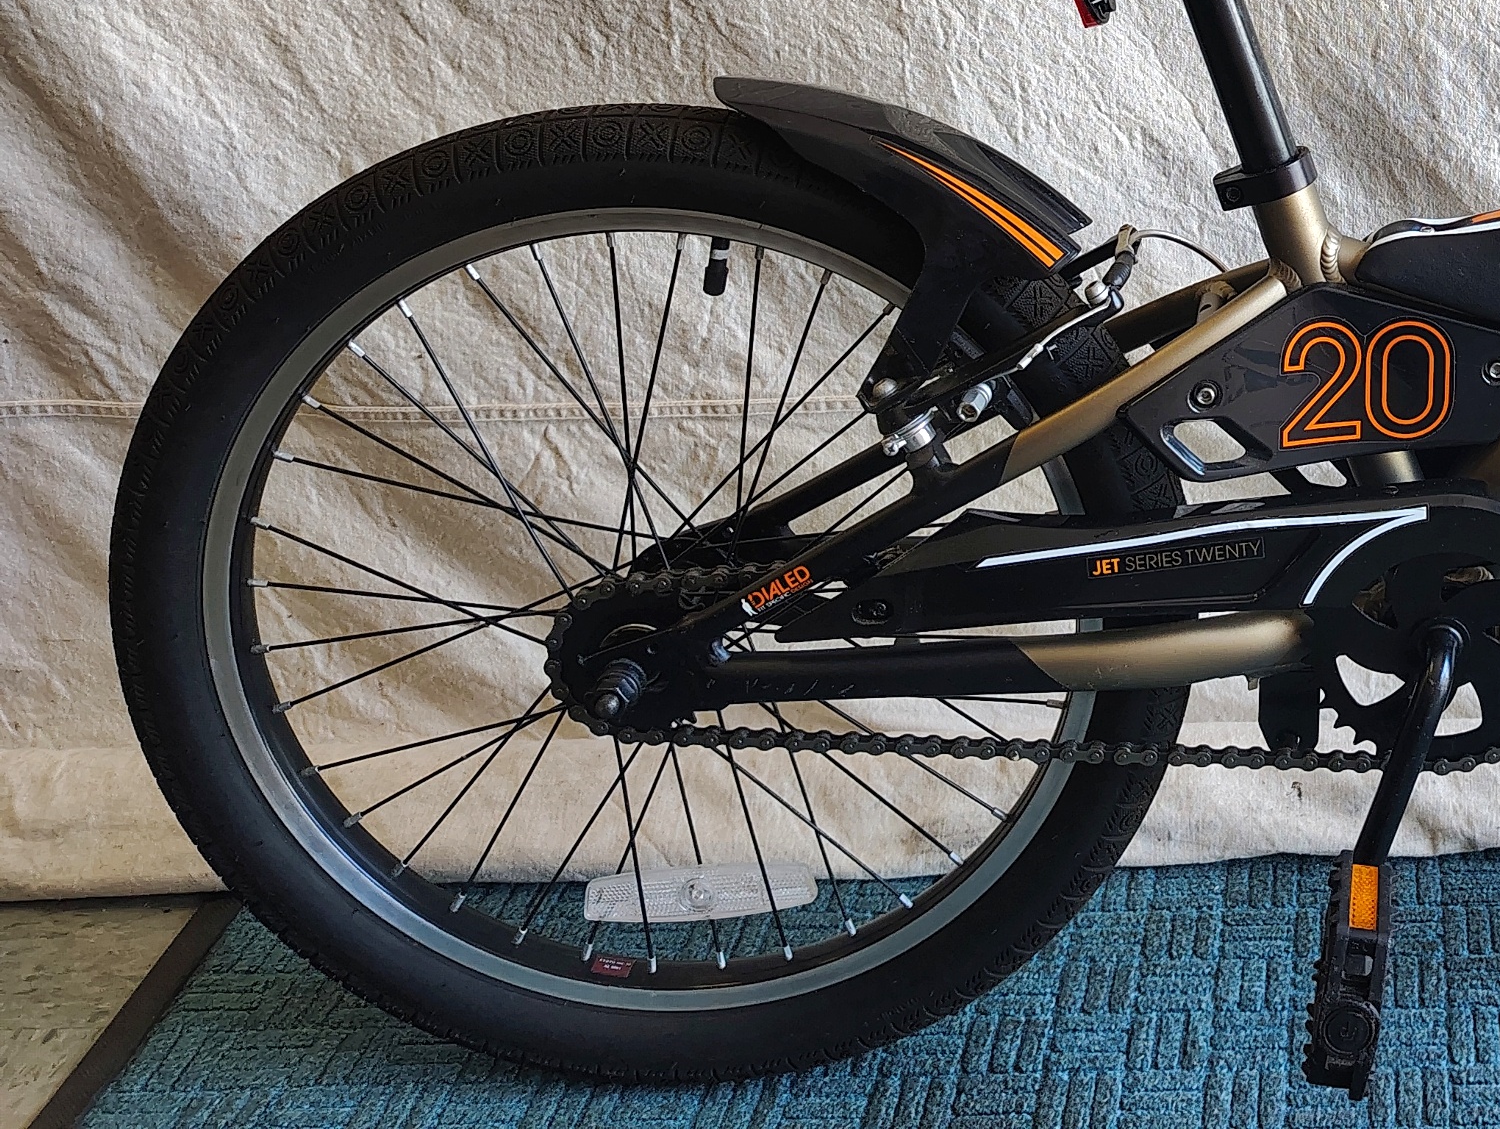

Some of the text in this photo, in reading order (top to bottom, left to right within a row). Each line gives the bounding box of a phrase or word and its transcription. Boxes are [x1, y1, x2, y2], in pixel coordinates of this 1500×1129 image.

[1282, 321, 1451, 447] 20
[1092, 539, 1261, 576] JET SERIES TWENTY
[747, 565, 811, 610] DIALED
